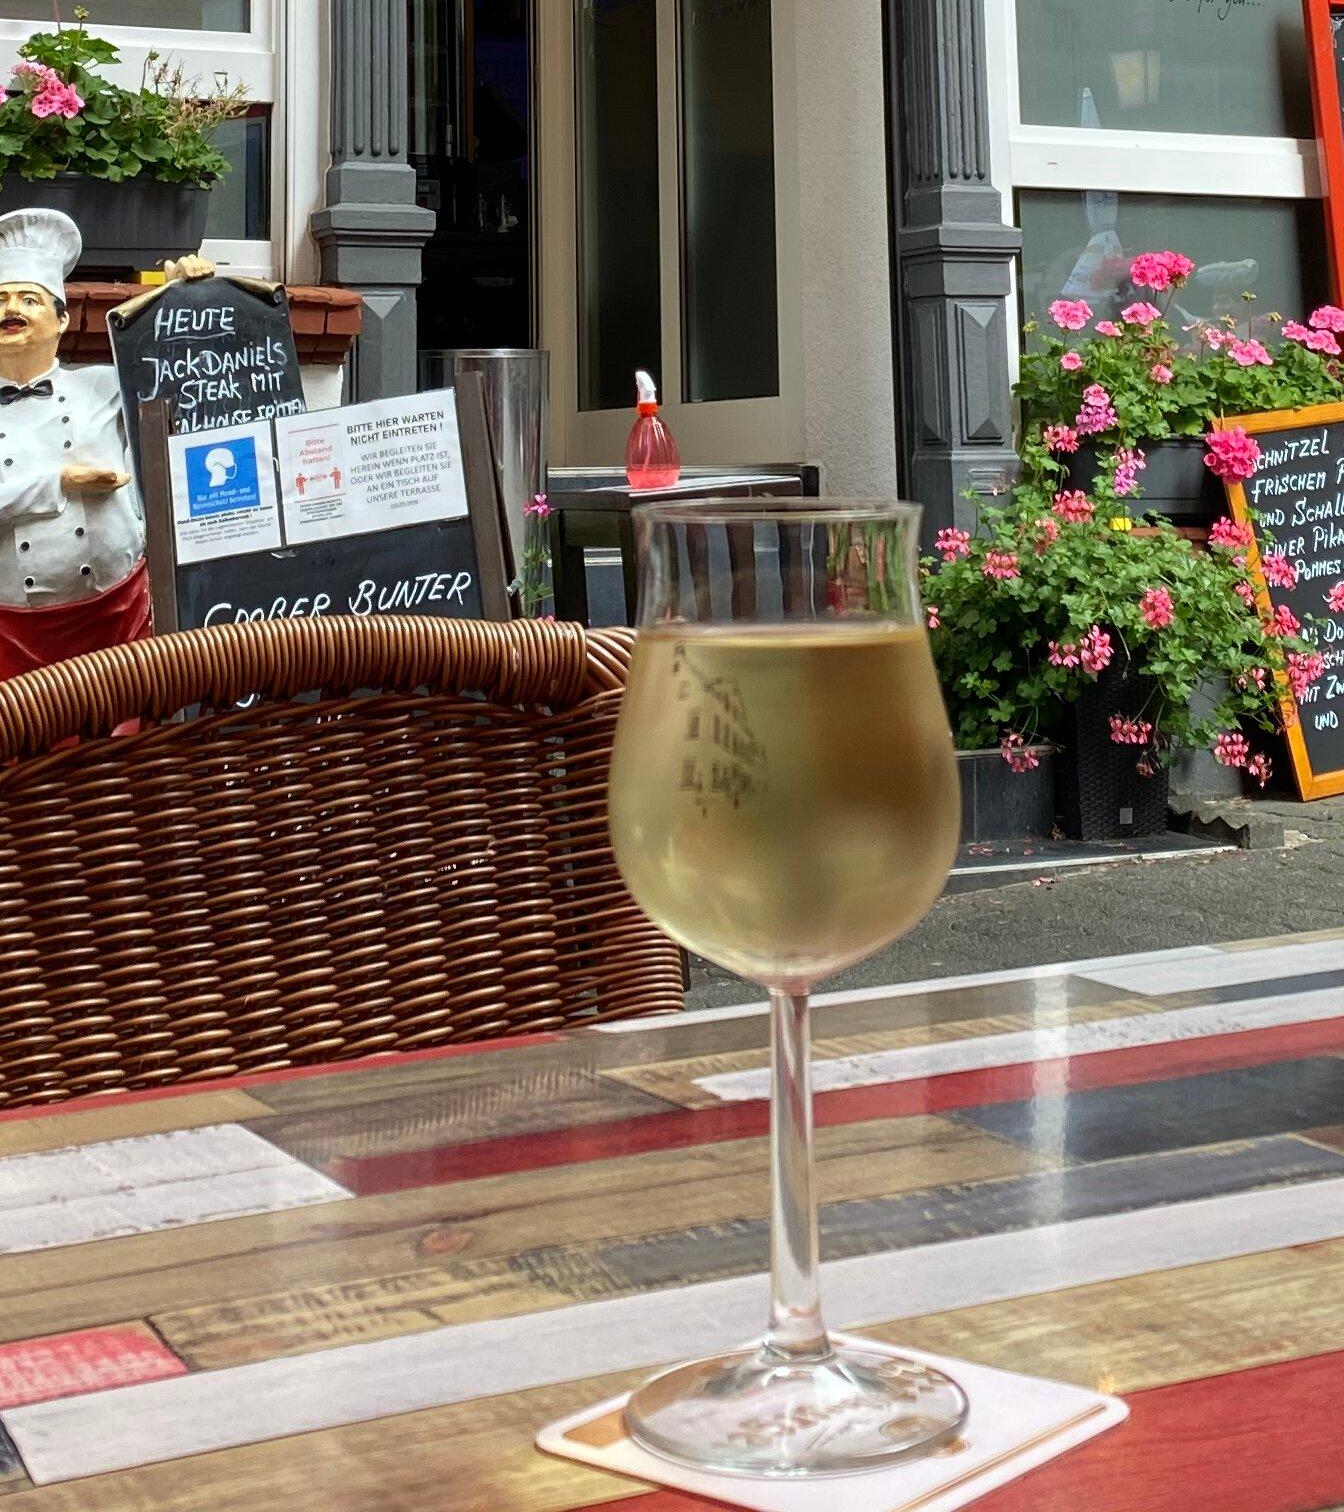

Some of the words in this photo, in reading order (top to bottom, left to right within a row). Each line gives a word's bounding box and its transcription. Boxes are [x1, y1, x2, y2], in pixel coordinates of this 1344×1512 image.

[154, 306, 235, 341] HEUTE
[177, 371, 243, 409] STEAK
[250, 366, 285, 393] MIT
[347, 424, 373, 434] BITTE
[375, 420, 399, 430] HIER
[402, 411, 445, 426] WARTEN
[350, 433, 379, 446] NICHT
[382, 425, 437, 439] EINTRETEN
[360, 452, 378, 462] WIR
[379, 445, 423, 458] BEGLEITEN
[424, 441, 438, 451] SIE
[350, 463, 381, 474] HEREIN
[410, 454, 435, 464] PLATZ
[350, 474, 374, 485] ODER
[440, 460, 453, 470] SIE
[349, 571, 472, 616] BUNTER
[1315, 710, 1339, 731] UND
